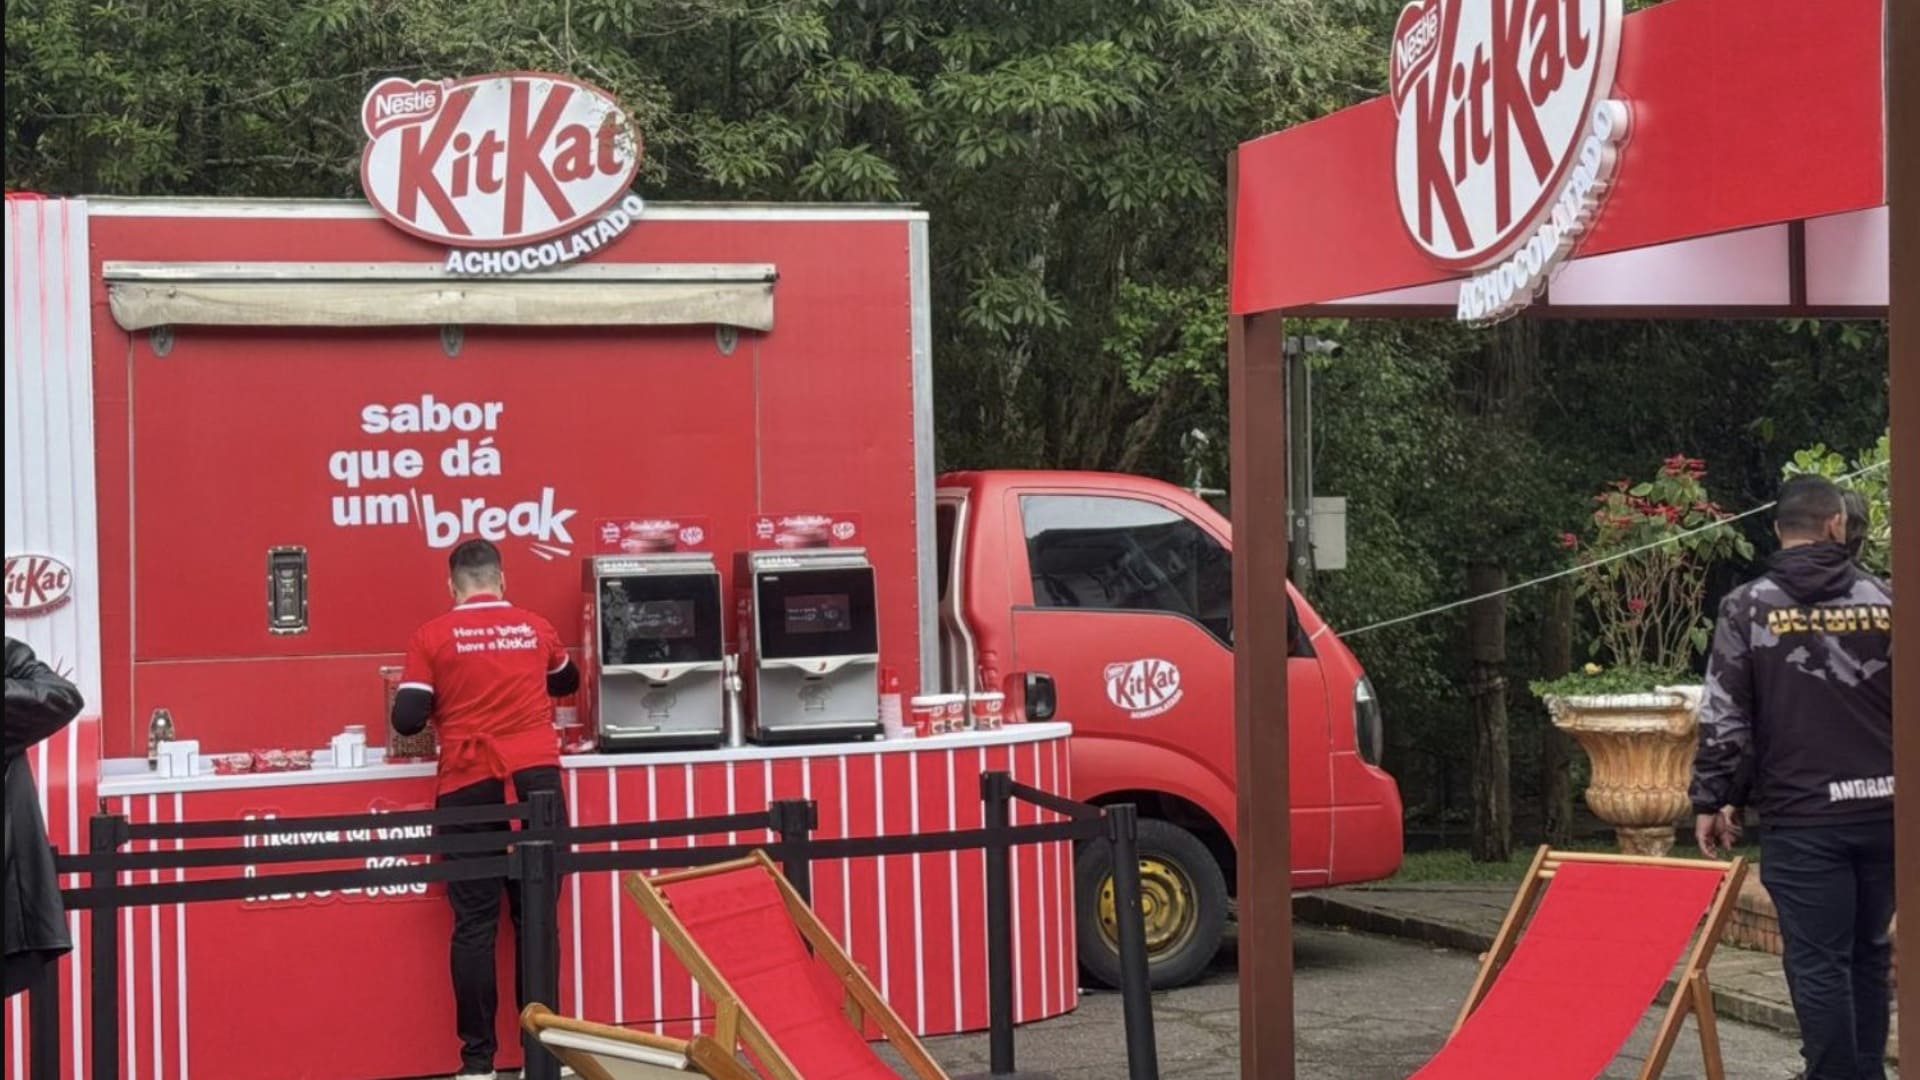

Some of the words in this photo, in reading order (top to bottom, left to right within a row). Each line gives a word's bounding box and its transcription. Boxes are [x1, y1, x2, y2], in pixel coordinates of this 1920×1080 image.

[397, 80, 624, 236] KitKat
[445, 195, 644, 273] ACHOCOLATADO
[361, 394, 503, 434] sabor
[329, 449, 424, 488] que
[440, 437, 501, 477] dá
[332, 493, 409, 526] um
[422, 486, 577, 548] break
[1115, 660, 1176, 708] KitKat
